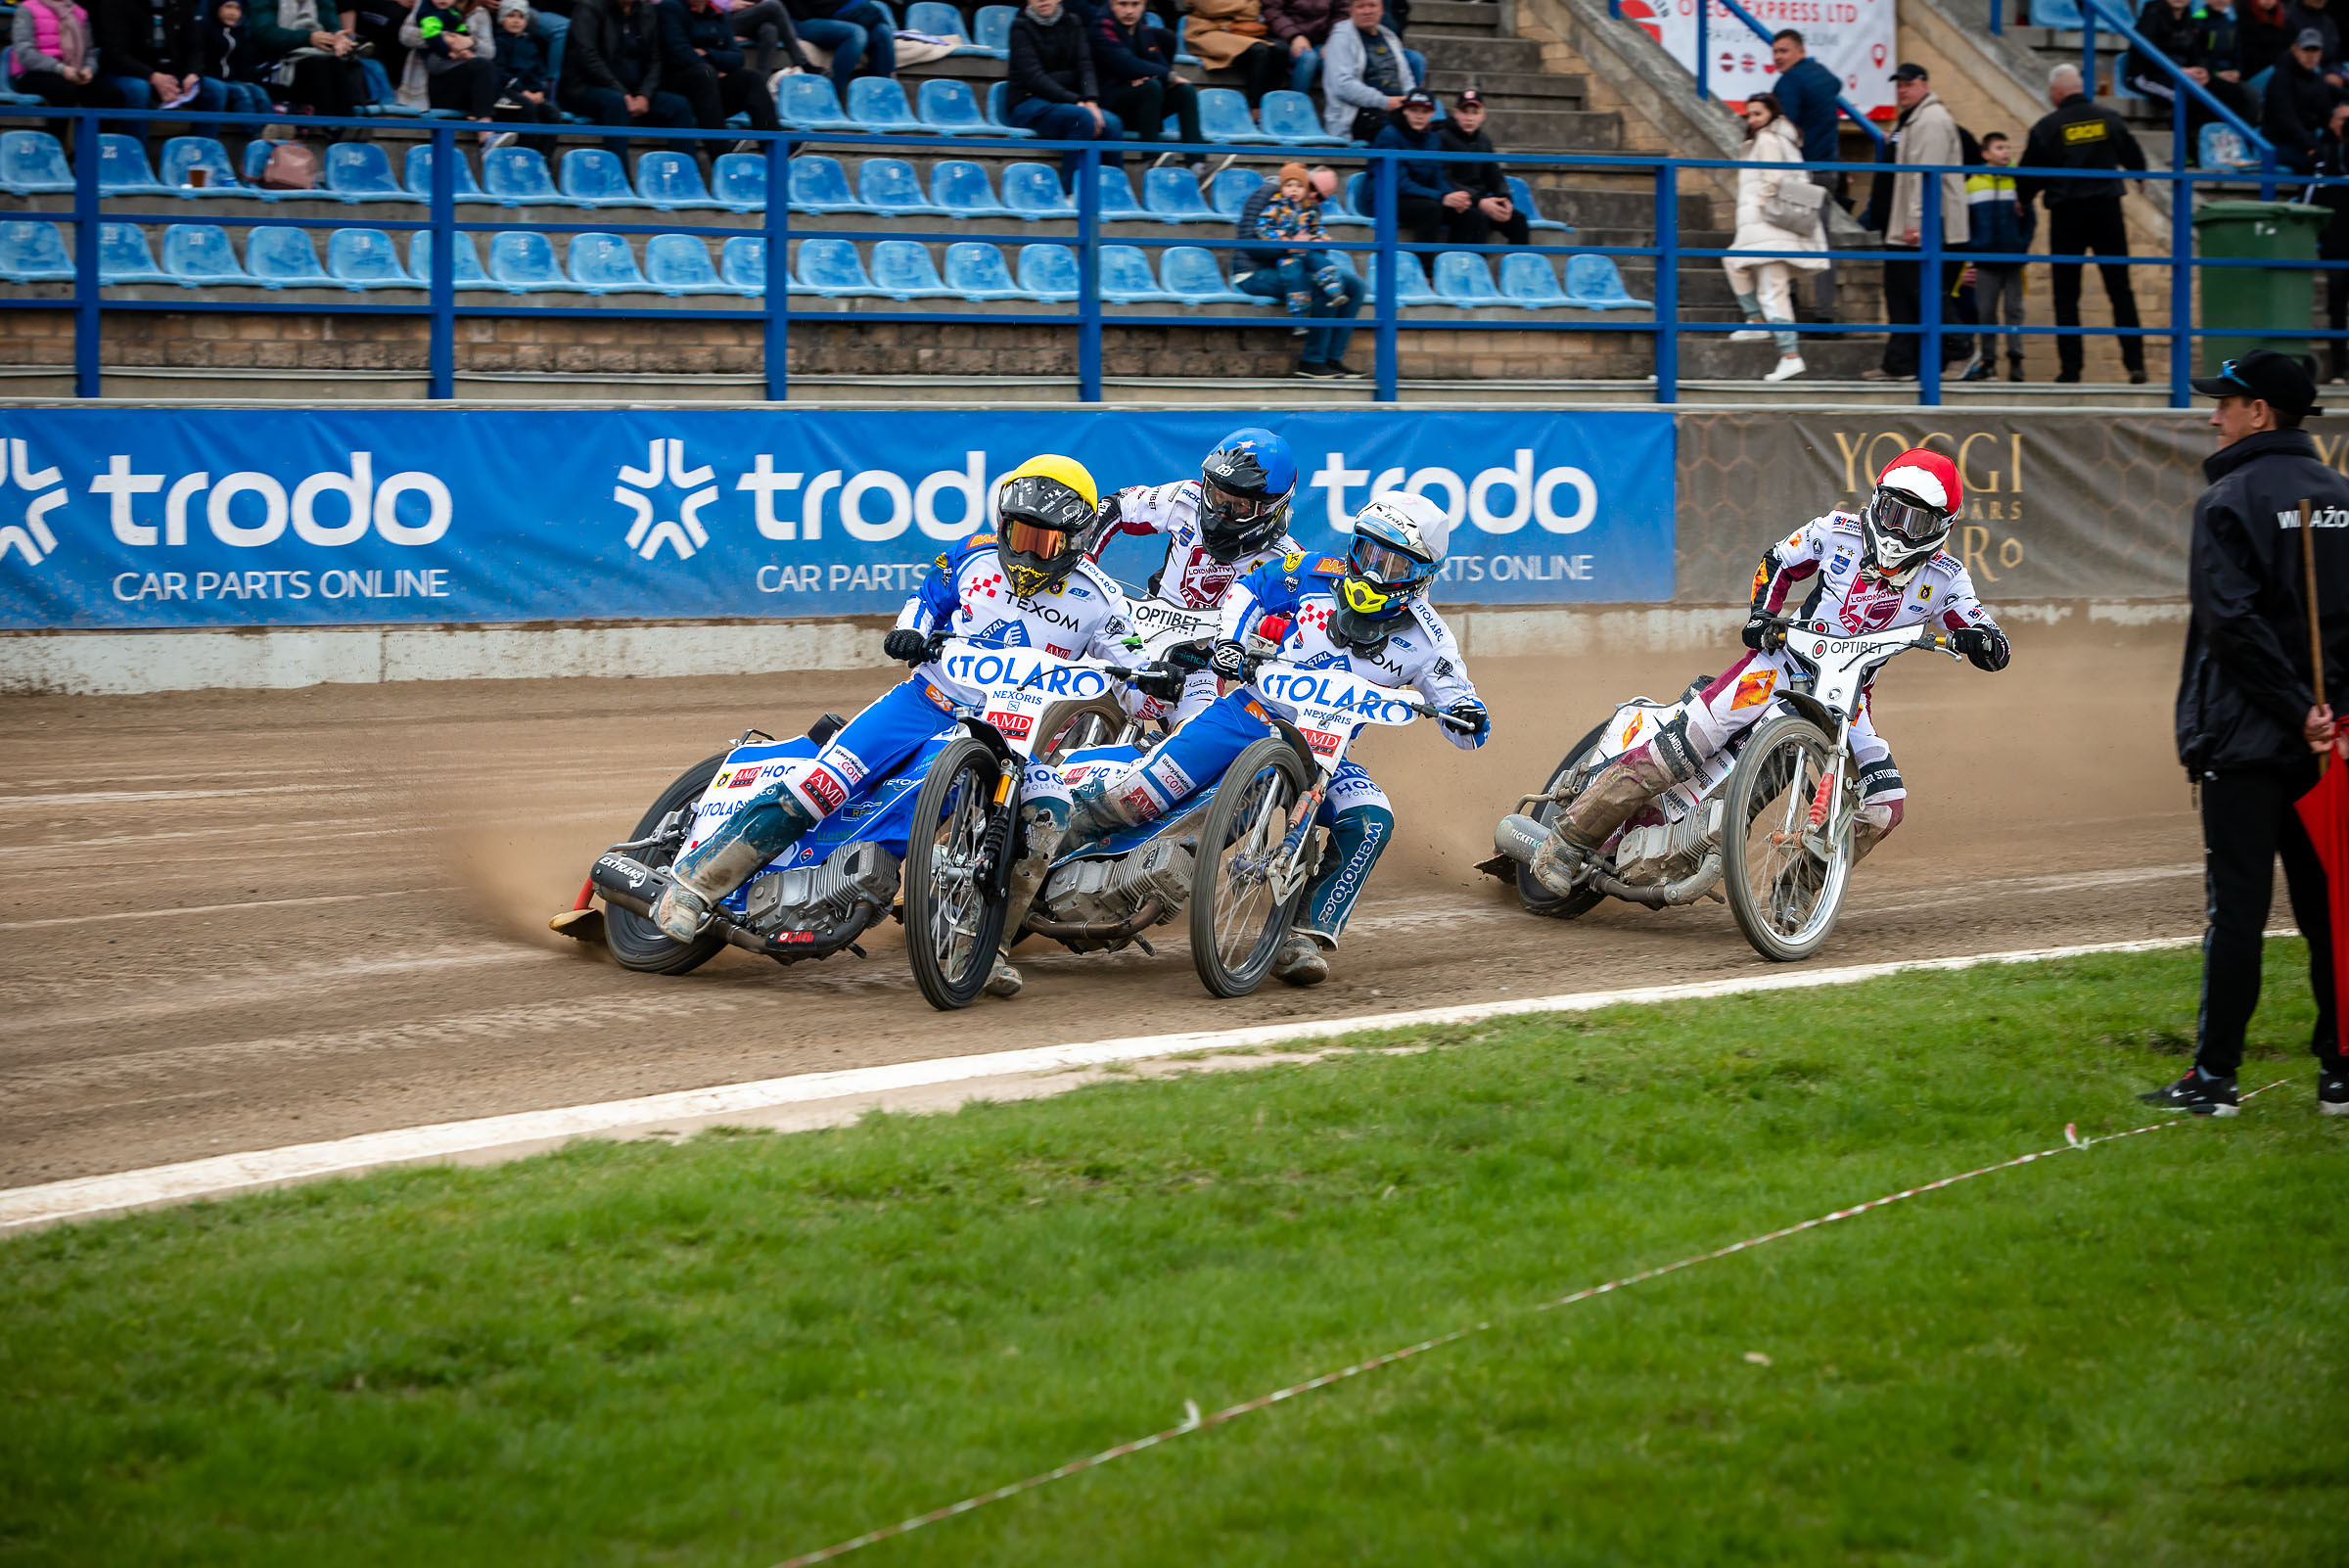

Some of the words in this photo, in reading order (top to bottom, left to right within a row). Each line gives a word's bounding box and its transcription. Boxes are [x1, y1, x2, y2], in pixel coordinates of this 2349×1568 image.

[1826, 4, 1858, 23] LTD
[89, 451, 452, 547] trodo
[1080, 561, 1117, 594] STOLARO
[1490, 555, 1593, 581] ONLINE
[114, 572, 187, 601] CAR
[197, 571, 310, 599] PARTS
[320, 569, 449, 598] ONLINE
[757, 565, 821, 592] CAR
[830, 564, 931, 591] PARTS
[1851, 591, 1895, 603] LOKOMOT
[1004, 589, 1080, 632] TEXOM
[1135, 606, 1202, 632] OPTIBET
[982, 620, 1006, 639] STAL
[1046, 646, 1071, 660] AMD
[1830, 641, 1882, 655] OPTIBET
[992, 690, 1043, 706] NEXORIS
[989, 713, 1032, 730] AMD
[1303, 708, 1353, 725] NEXORIS
[1303, 729, 1339, 747] AMD
[734, 767, 760, 780] AMD
[810, 772, 845, 807] AMD
[1162, 775, 1186, 797] .com
[1335, 780, 1382, 795] HOG
[1346, 790, 1382, 799] POLSKA
[698, 800, 744, 818] STOLAR
[597, 855, 647, 883] EXTRANS
[1318, 822, 1383, 923] wemoto.cz
